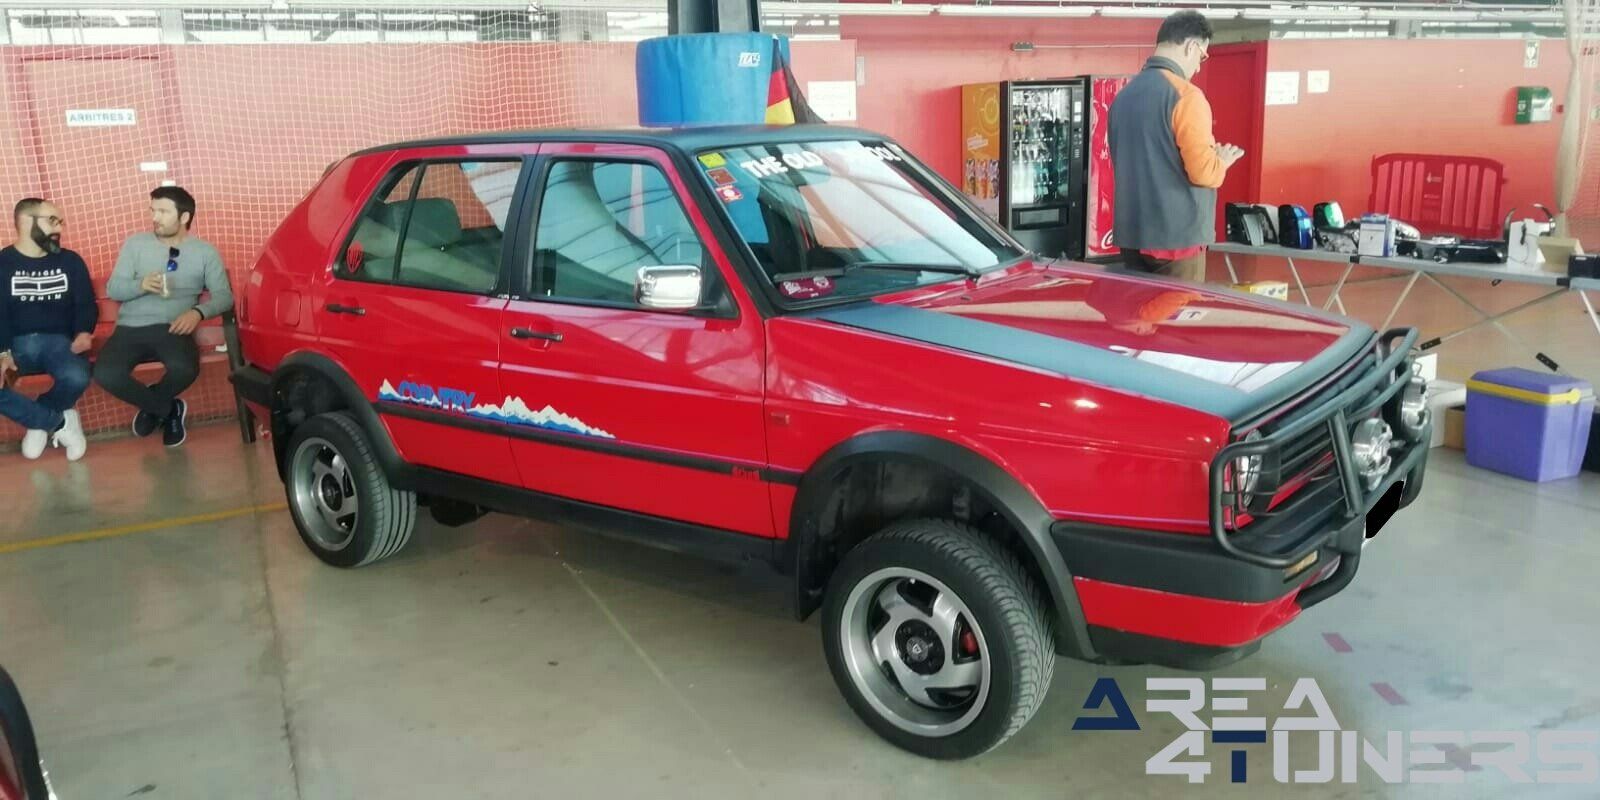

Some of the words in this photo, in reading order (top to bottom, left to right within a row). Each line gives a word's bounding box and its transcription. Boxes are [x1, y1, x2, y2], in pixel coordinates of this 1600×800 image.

[69, 112, 124, 122] ARBITRES
[127, 112, 133, 121] 2
[740, 156, 788, 178] THE
[782, 150, 823, 170] OLD
[15, 267, 62, 278] HILFIGER
[20, 293, 62, 302] DENIM
